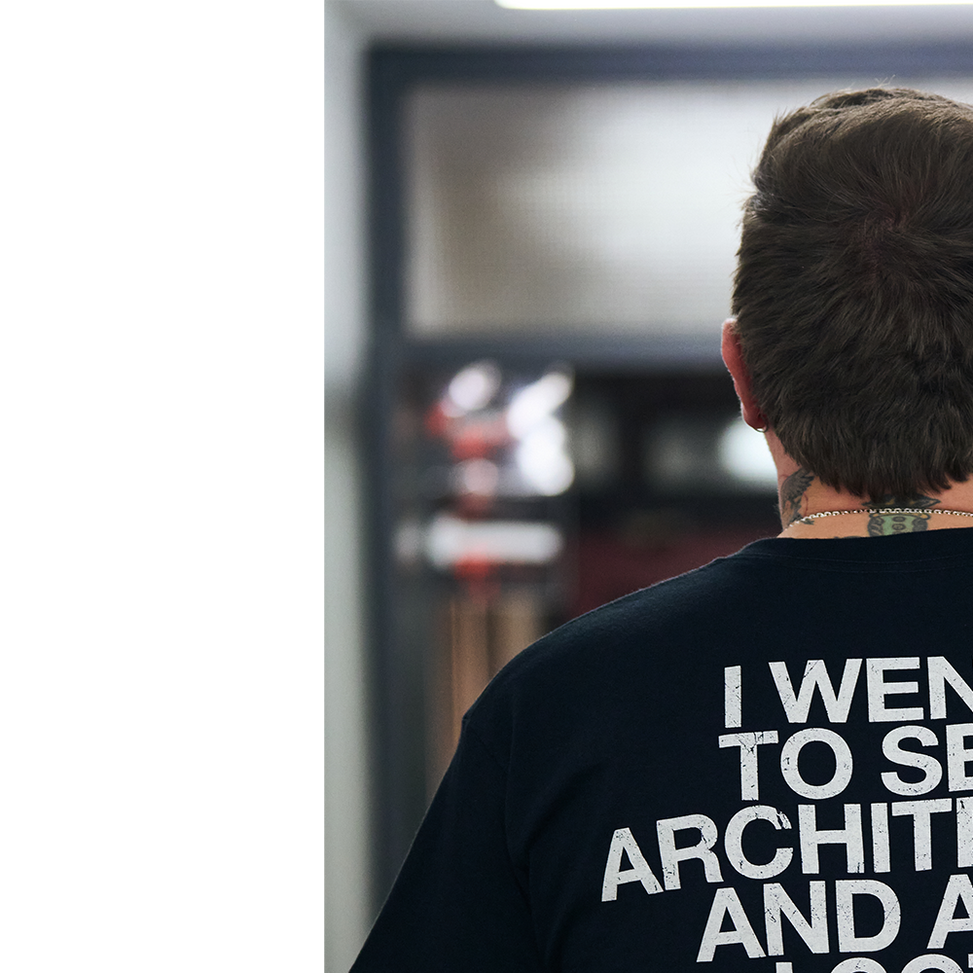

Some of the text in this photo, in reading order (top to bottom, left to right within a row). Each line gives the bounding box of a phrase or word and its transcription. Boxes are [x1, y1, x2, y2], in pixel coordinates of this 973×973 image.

[725, 666, 742, 728] I
[719, 728, 853, 800] TO
[697, 875, 901, 962] AND
